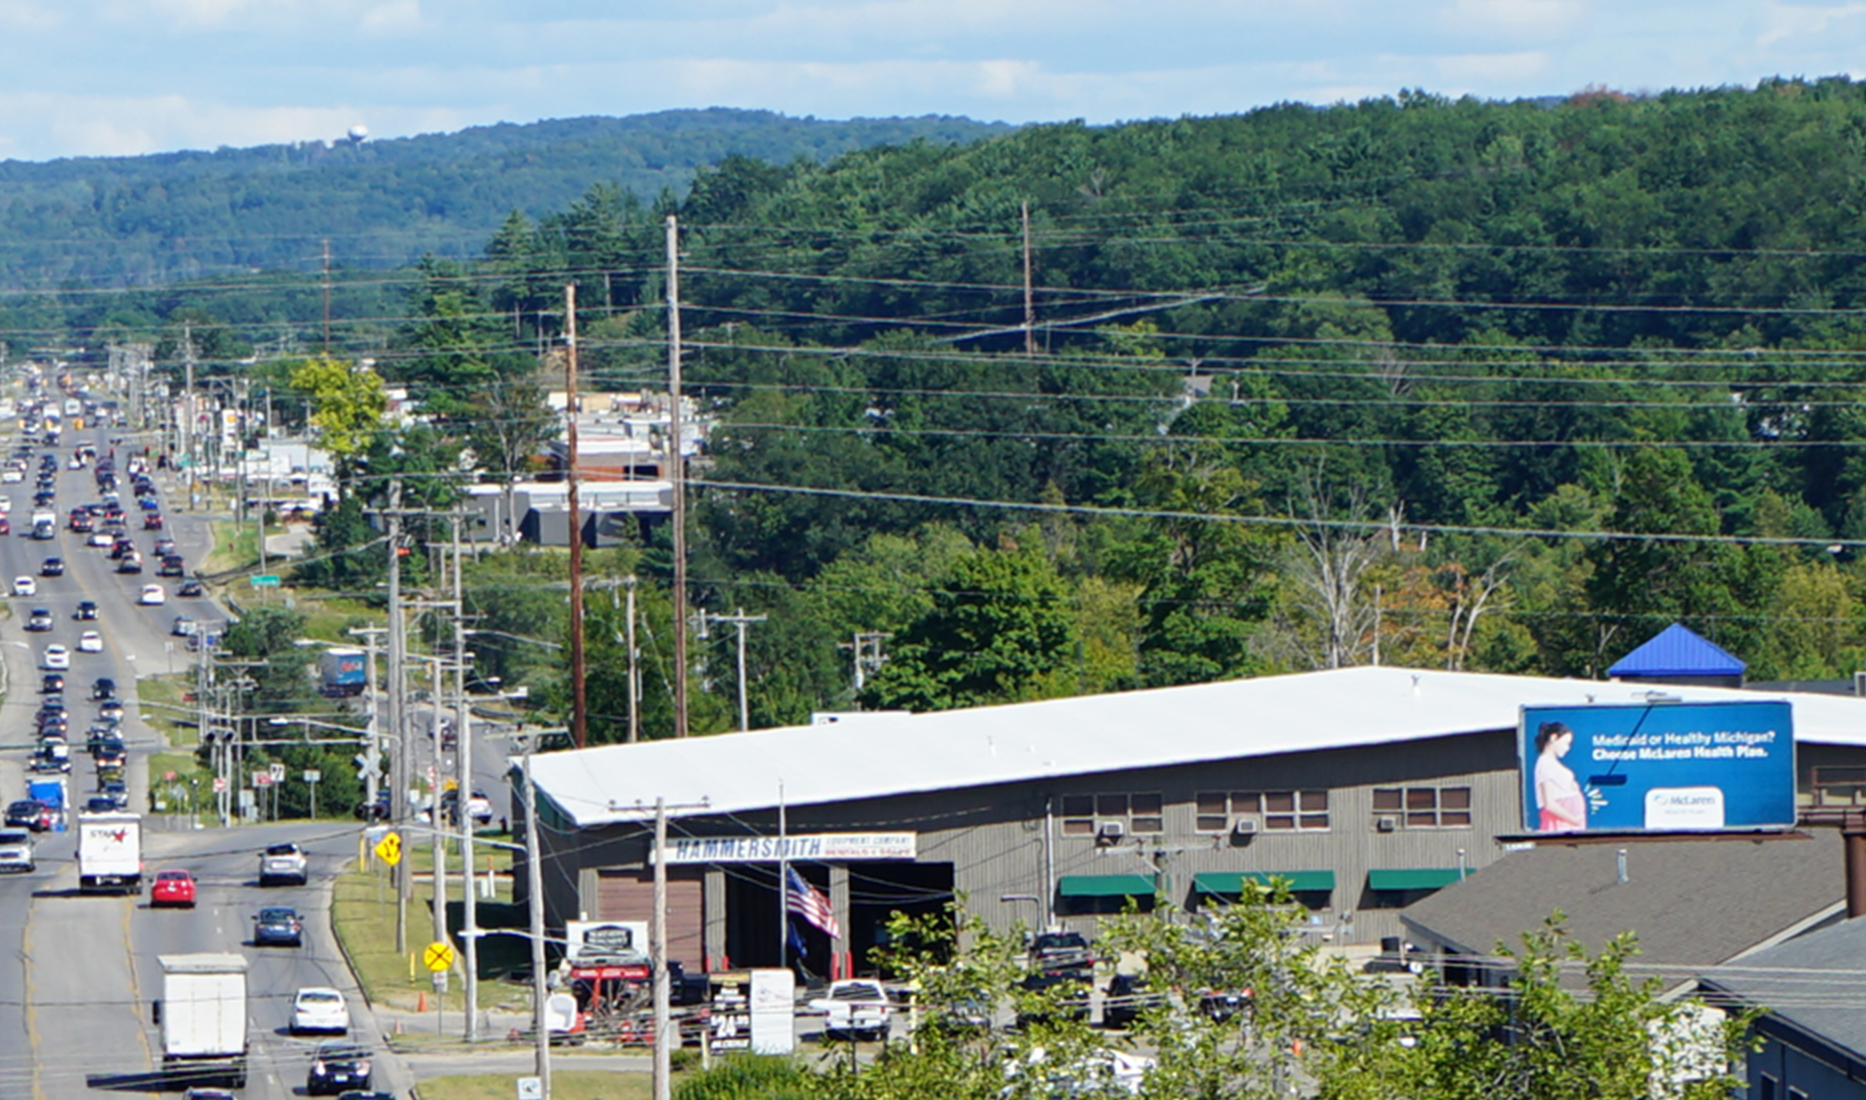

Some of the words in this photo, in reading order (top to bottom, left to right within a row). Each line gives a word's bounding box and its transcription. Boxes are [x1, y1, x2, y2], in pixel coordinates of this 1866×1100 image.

[1592, 733, 1647, 746] Medicaid
[1648, 735, 1663, 745] or
[1664, 732, 1712, 747] Healthy
[1714, 731, 1776, 746] Michigan?
[1592, 748, 1637, 761] Choose
[1639, 747, 1692, 760] McLaren
[1693, 746, 1734, 759] Health
[1736, 745, 1769, 758] Plan.
[1670, 796, 1716, 805] McLaren
[676, 838, 821, 860] HAMMERSMITH
